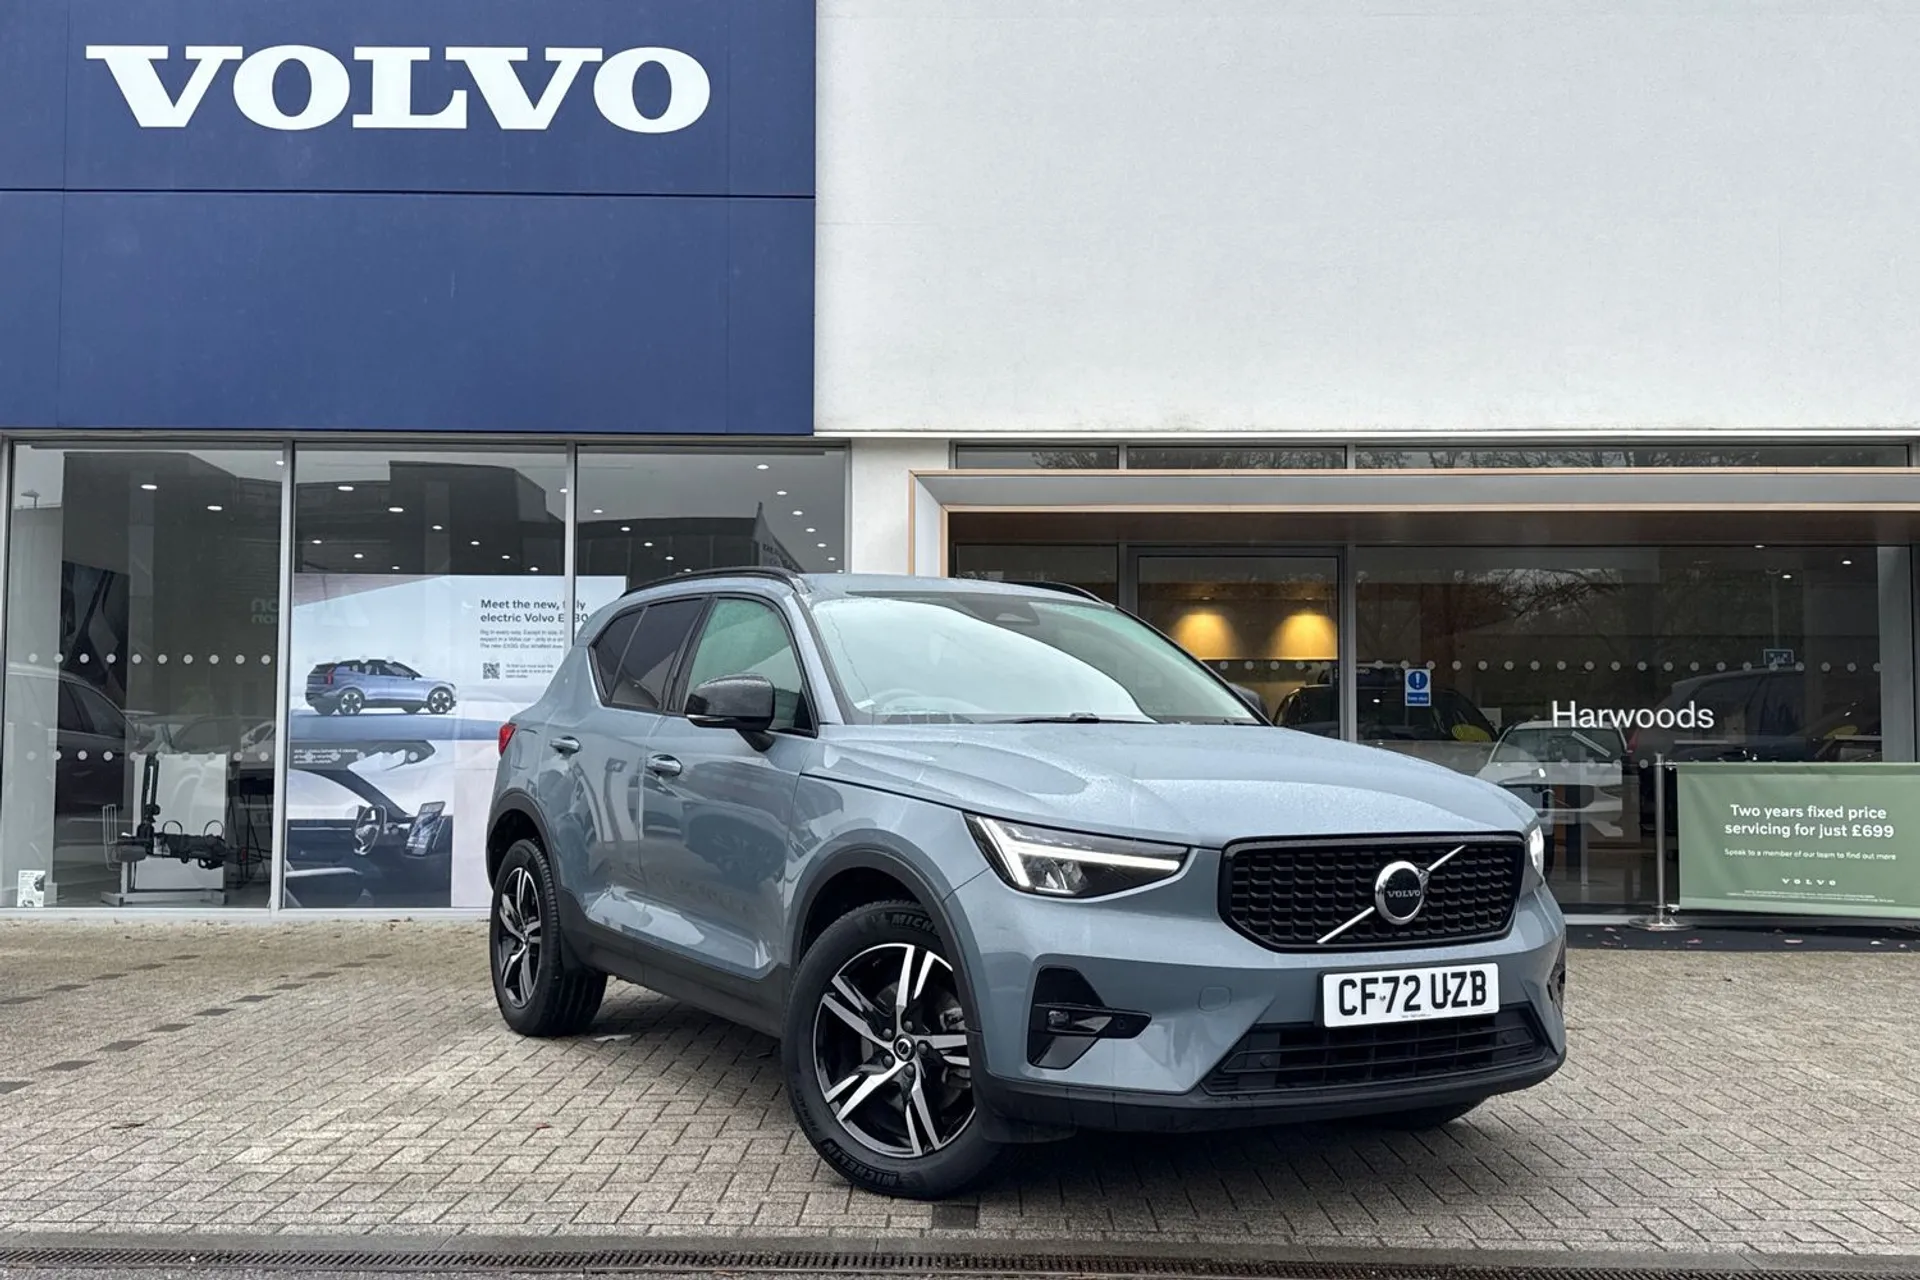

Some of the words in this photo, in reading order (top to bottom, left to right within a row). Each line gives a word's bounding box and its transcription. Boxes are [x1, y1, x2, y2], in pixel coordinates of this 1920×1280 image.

[86, 44, 711, 134] VOLVO
[481, 600, 511, 609] Meet
[513, 600, 532, 609] the
[534, 602, 559, 610] new,
[480, 613, 521, 623] electric
[524, 613, 554, 623] Volvo
[1552, 700, 1715, 729] Harwoods
[1730, 804, 1760, 817] Two
[1764, 807, 1804, 820] years
[1807, 805, 1844, 819] fixed
[1848, 806, 1887, 822] price
[1724, 823, 1790, 838] servicing
[1795, 823, 1815, 836] for
[1819, 824, 1847, 839] just
[1852, 825, 1894, 838] £699
[1724, 848, 1746, 857] Speak
[1763, 850, 1792, 858] member
[1817, 851, 1835, 859] team
[1837, 851, 1845, 859] to
[1847, 851, 1861, 860] find
[1862, 852, 1875, 860] out
[1782, 878, 1836, 886] VOLVO
[1386, 889, 1421, 898] VOLVO
[1338, 975, 1421, 1016] CF72
[1430, 970, 1487, 1009] UZB
